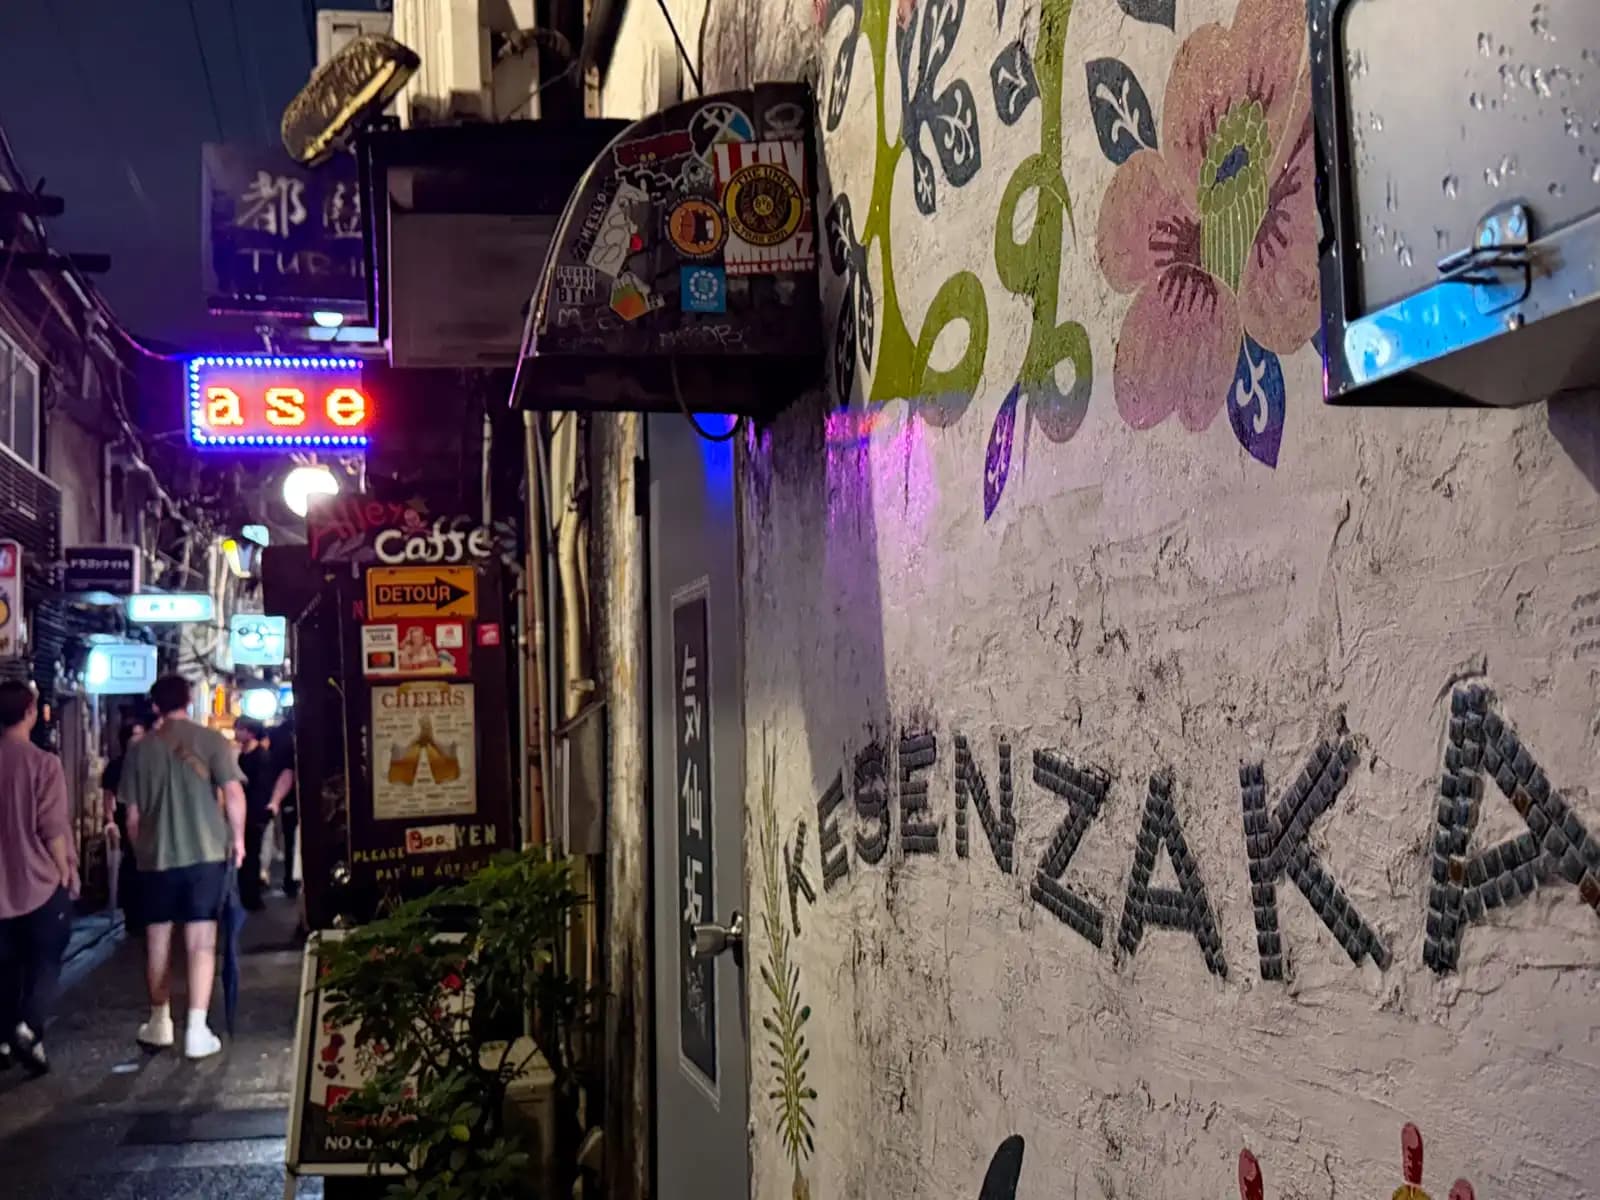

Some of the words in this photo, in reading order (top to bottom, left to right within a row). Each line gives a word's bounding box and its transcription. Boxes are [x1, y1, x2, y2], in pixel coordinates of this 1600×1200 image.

[378, 584, 451, 603] DETOUR
[381, 688, 465, 710] CHEERS
[456, 823, 497, 848] YEN
[783, 680, 1600, 980] KESENZAKA
[352, 846, 406, 864] PLEASE
[375, 867, 402, 881] PAY
[411, 864, 425, 878] IN
[324, 1135, 352, 1151] NO
